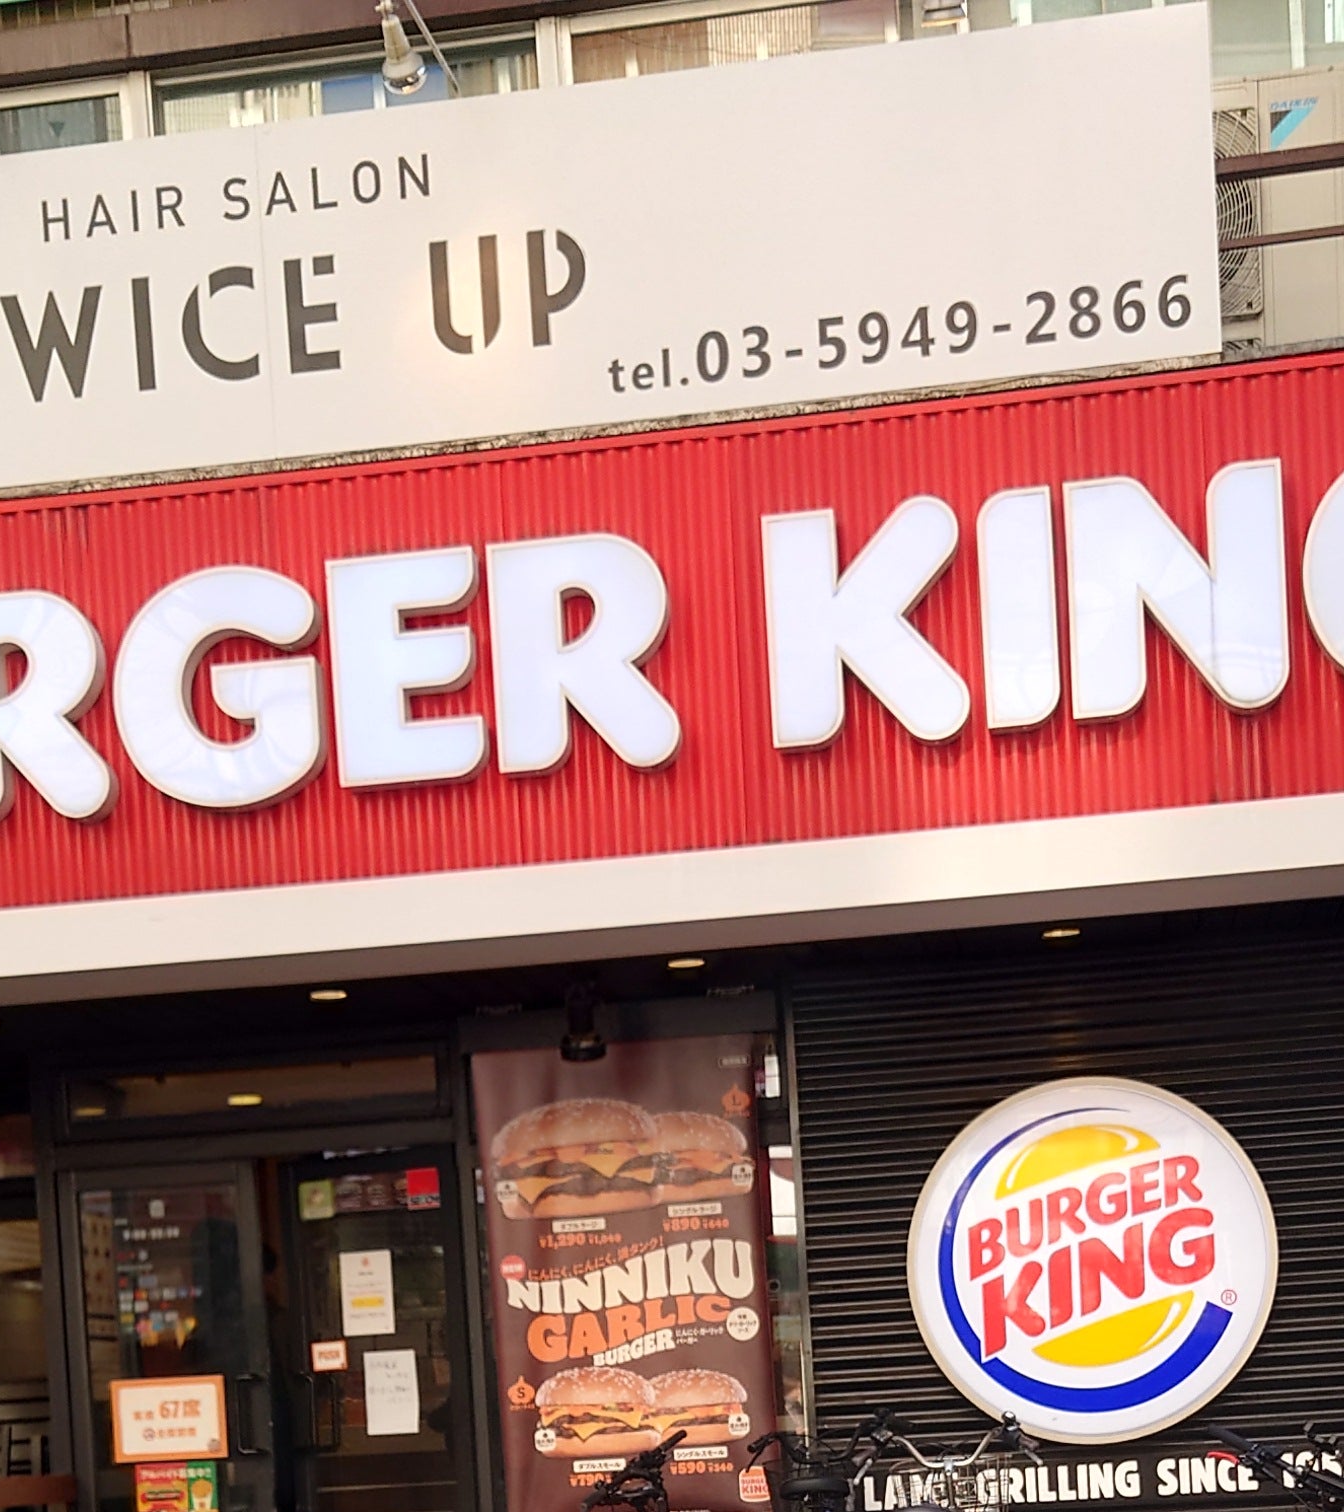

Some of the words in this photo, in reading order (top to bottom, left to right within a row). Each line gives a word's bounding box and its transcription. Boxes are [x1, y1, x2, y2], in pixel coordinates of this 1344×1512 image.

[42, 185, 187, 243] HAIR
[222, 152, 433, 222] SALON
[428, 228, 587, 356] UP
[607, 274, 1193, 395] tel.03-5949-2866
[967, 1155, 1204, 1281] BURGER
[506, 1238, 755, 1314] NINNIKU
[981, 1207, 1216, 1358] KING
[527, 1295, 731, 1363] GARLIC
[592, 1328, 677, 1367] BURGER
[977, 1459, 1141, 1505] GRILLING
[1156, 1455, 1260, 1497] SINCE
